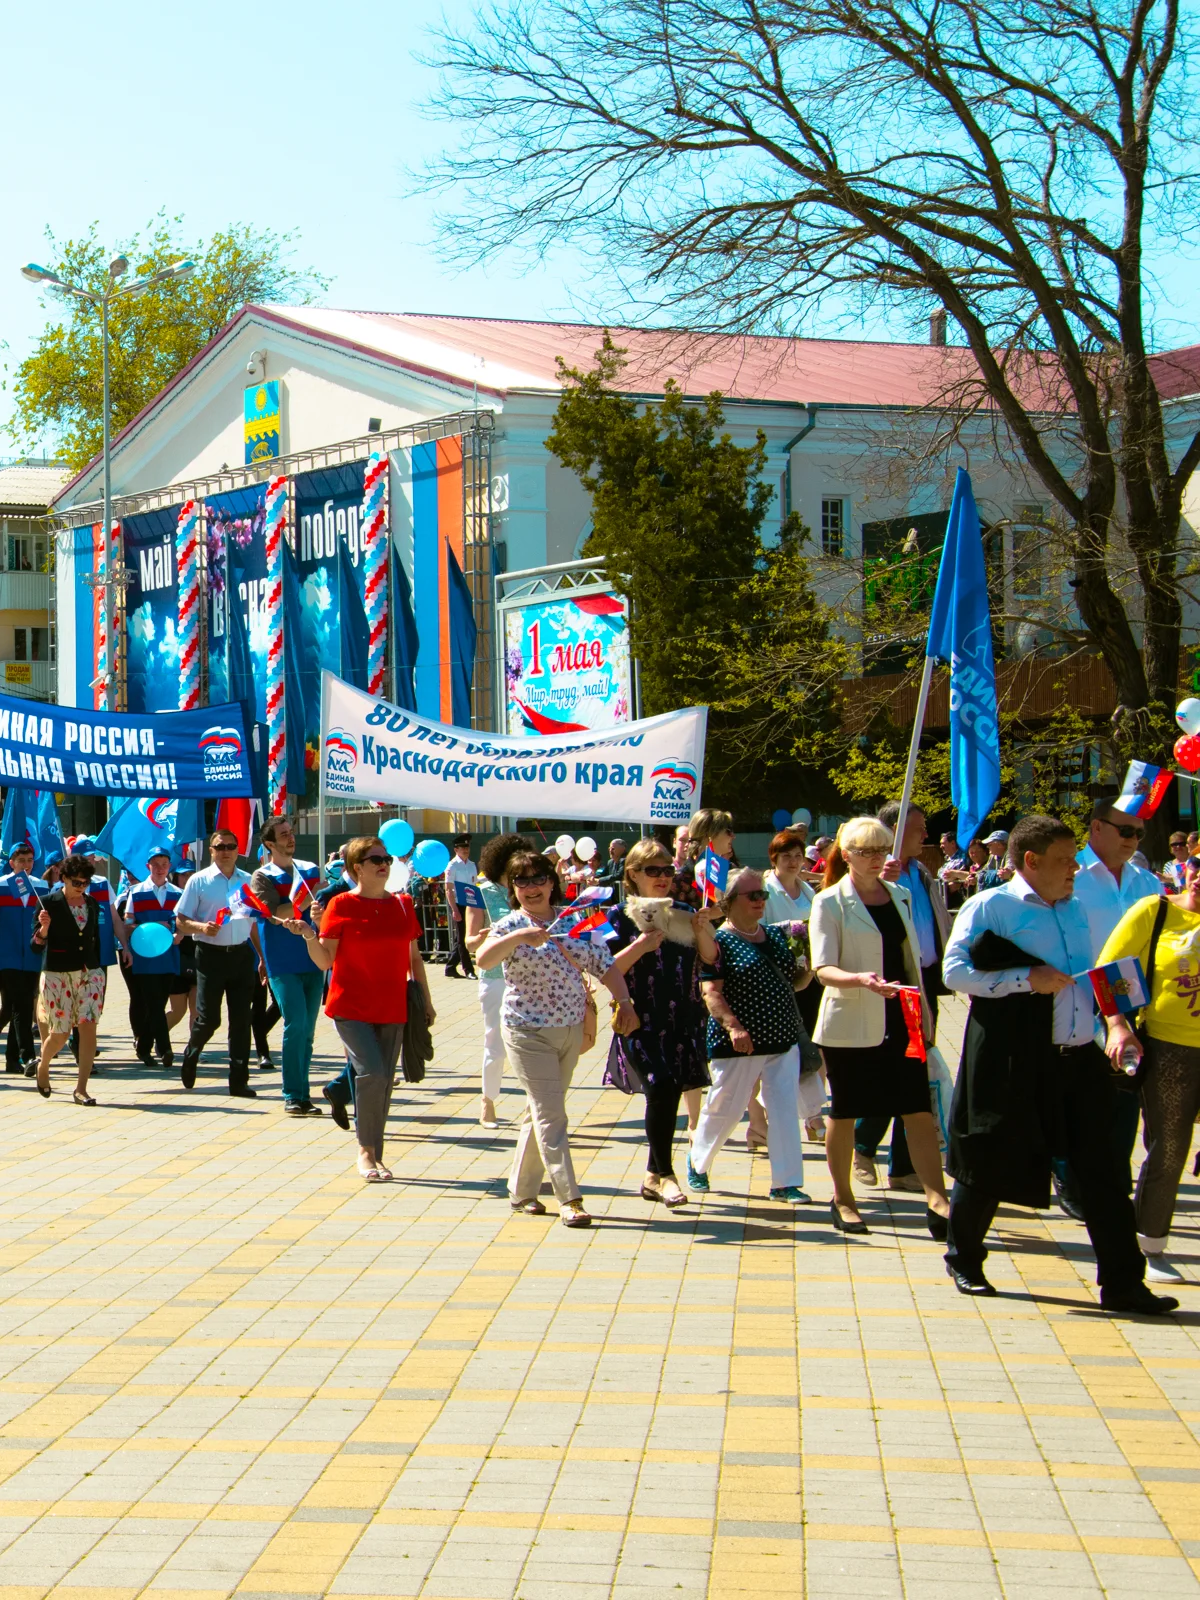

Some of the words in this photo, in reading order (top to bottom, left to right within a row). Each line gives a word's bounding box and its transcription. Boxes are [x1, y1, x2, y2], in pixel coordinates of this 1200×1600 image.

[301, 500, 367, 567] победа
[140, 535, 172, 592] май
[213, 577, 269, 637] всна
[529, 623, 542, 674] 1
[552, 641, 604, 673] мая
[524, 687, 548, 706] Мир,
[551, 687, 579, 706] труд,
[582, 678, 608, 697] май!
[65, 721, 164, 756] РОССИЯ-
[365, 703, 409, 733] 80
[408, 724, 459, 751] лет
[74, 761, 178, 790] РОССИЯ!
[203, 763, 242, 774] ЕДИНАЯ
[205, 771, 243, 782] РОССИЯ
[326, 772, 355, 784] ЕДИНАЯ
[362, 735, 567, 787] Краснодарского
[575, 762, 643, 793] края
[326, 781, 355, 793] РОССИЯ
[650, 801, 691, 811] ЕДИНАЯ
[650, 809, 691, 819] РОССИЯ
